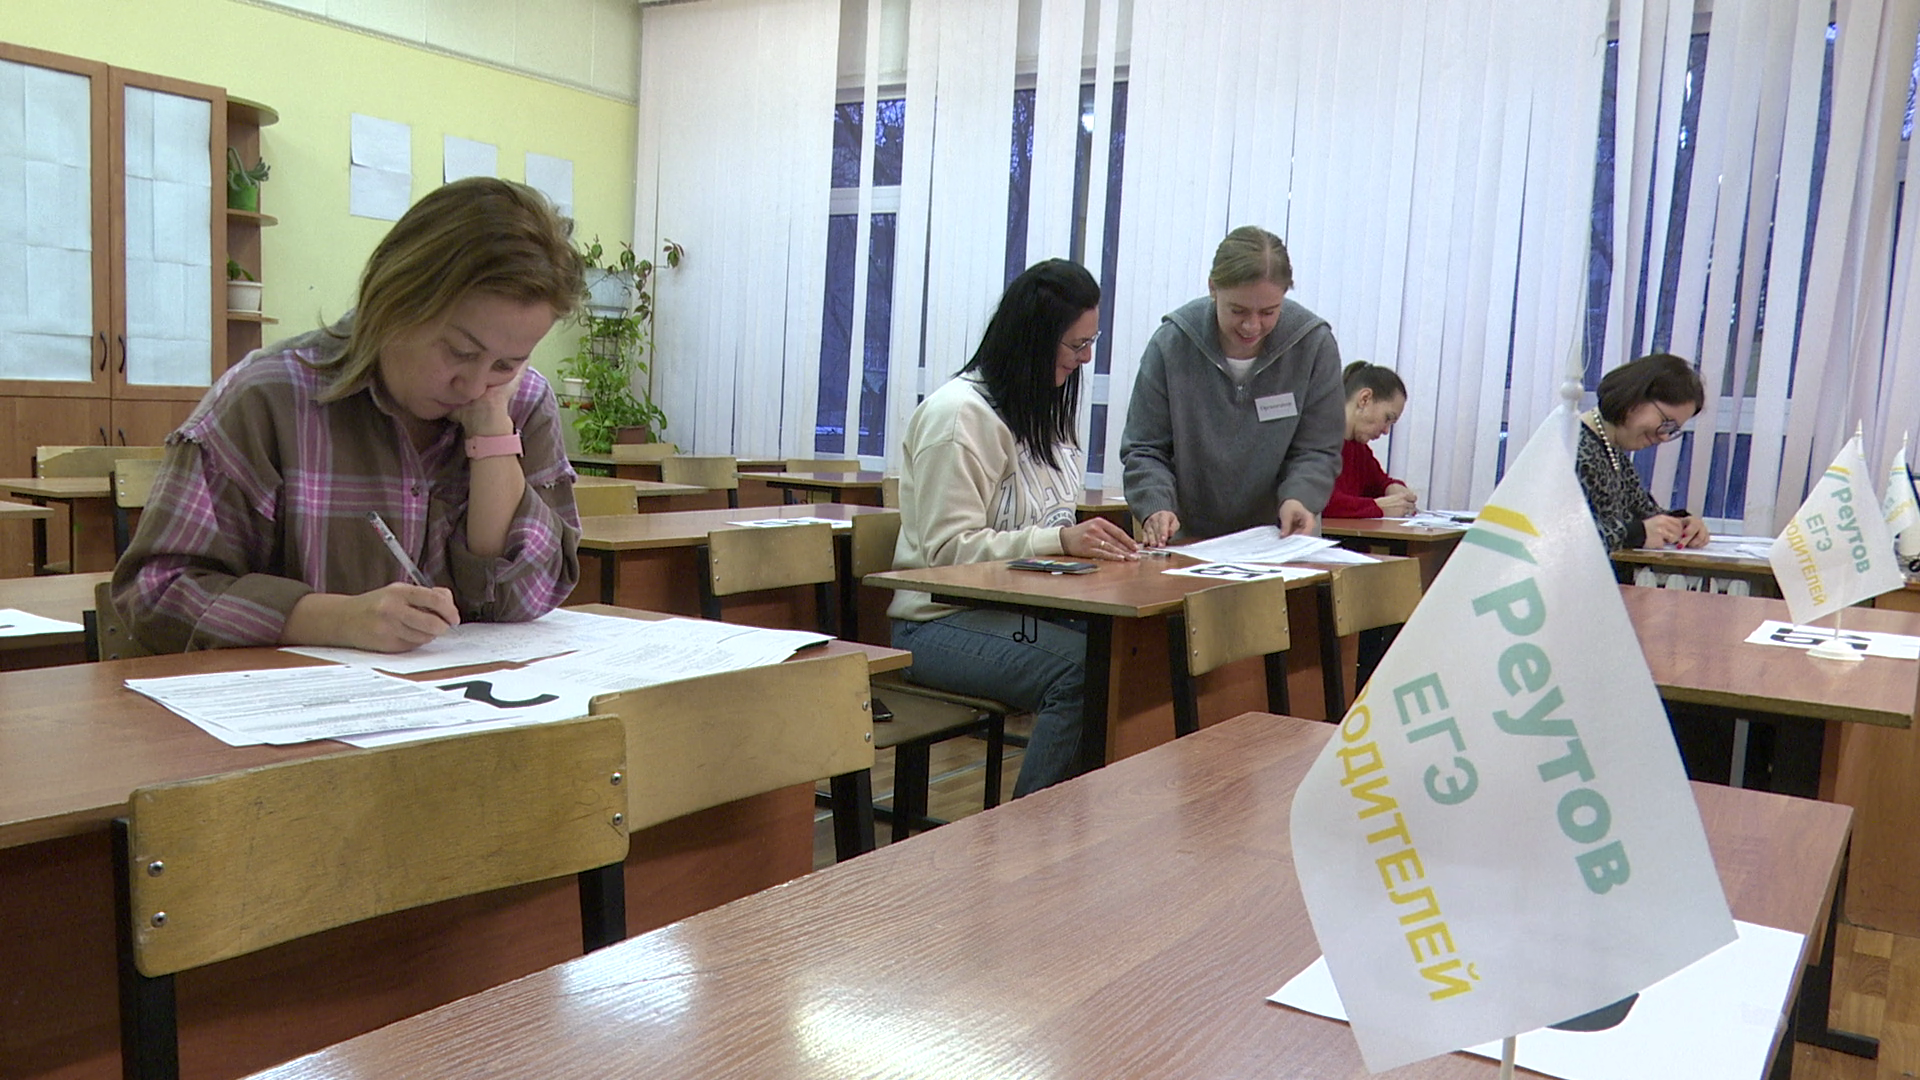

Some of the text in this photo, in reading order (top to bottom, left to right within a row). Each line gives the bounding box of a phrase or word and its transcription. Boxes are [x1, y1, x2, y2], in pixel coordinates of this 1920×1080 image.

[1786, 519, 1828, 607] ОДИТЕЛЕЙ
[1806, 514, 1833, 552] ЕГЭ
[1830, 486, 1871, 574] Реутов
[1392, 672, 1478, 806] ЕГЭ
[1472, 577, 1631, 896] Реутов
[1335, 680, 1481, 1001] ОДИТЕЛЕЙ
